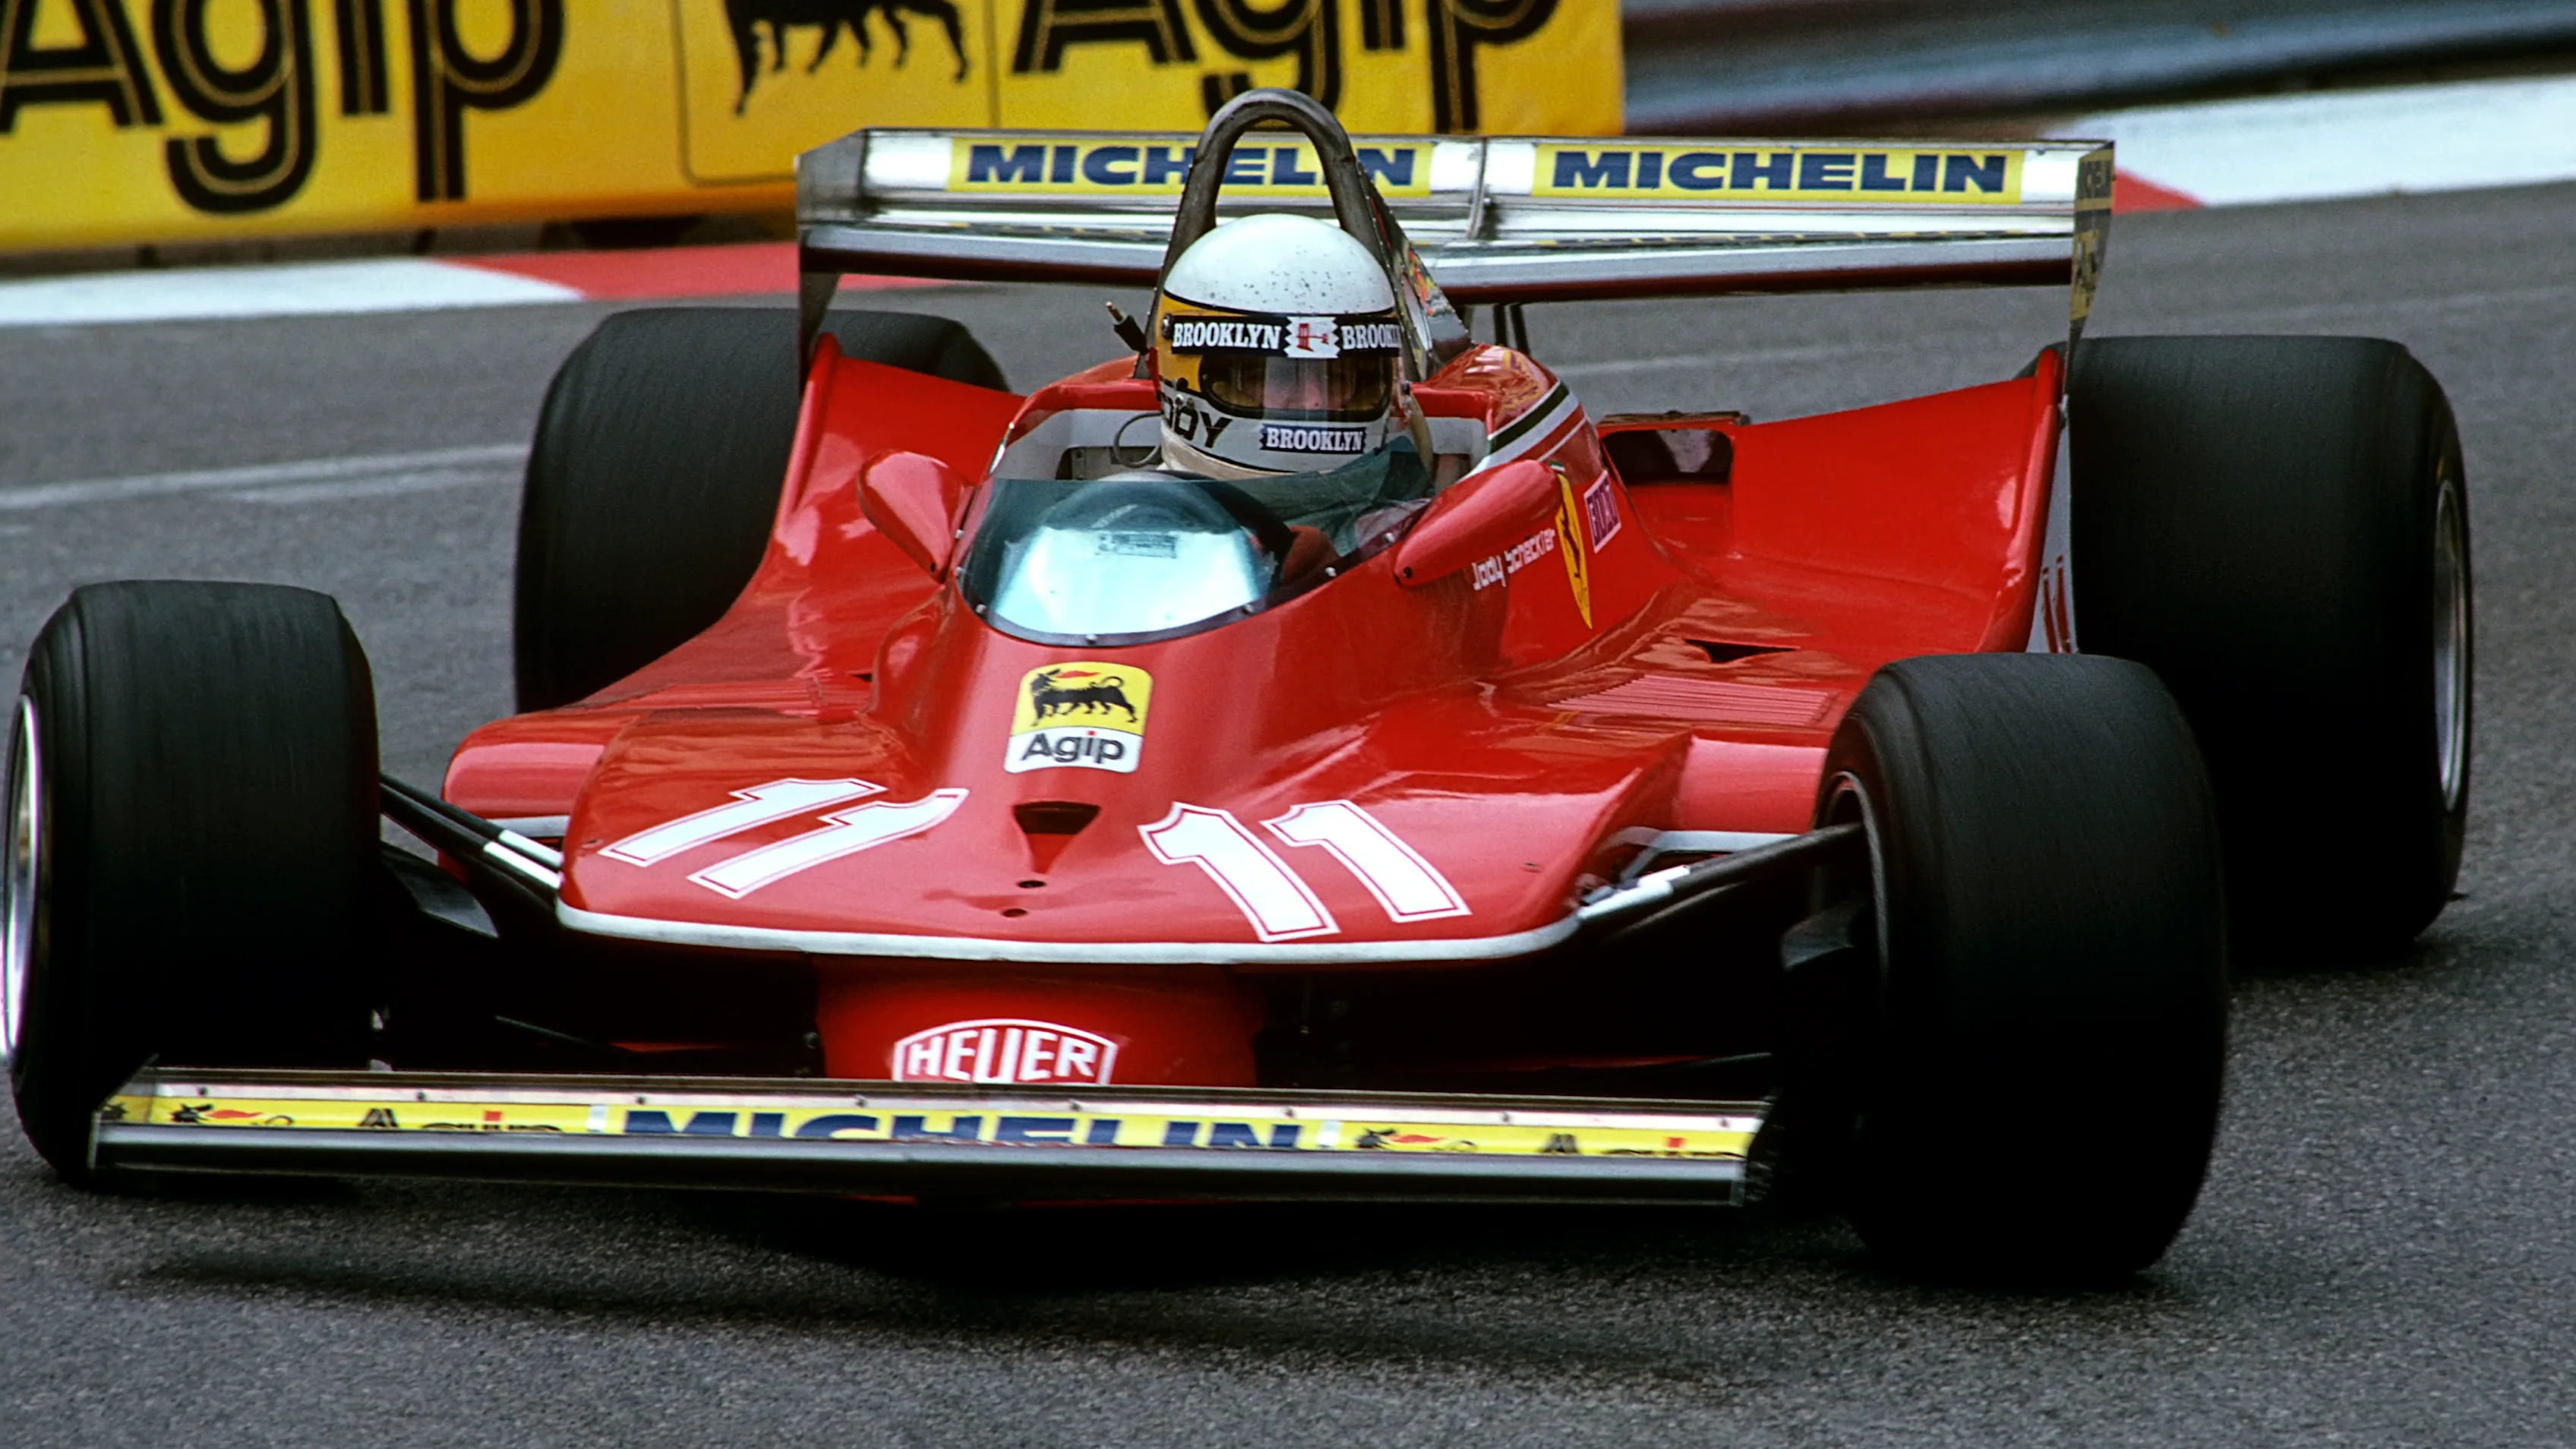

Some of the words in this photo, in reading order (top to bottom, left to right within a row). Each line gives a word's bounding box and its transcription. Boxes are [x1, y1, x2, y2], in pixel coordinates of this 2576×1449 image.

[1552, 151, 2006, 194] MICHELIN
[1172, 321, 1283, 350] BROOKLYN
[1266, 426, 1364, 453] BROOKLYN
[1021, 730, 1126, 764] Agip
[598, 778, 971, 900] 11
[1138, 799, 1473, 943] 11
[907, 1028, 1098, 1083] HEUER
